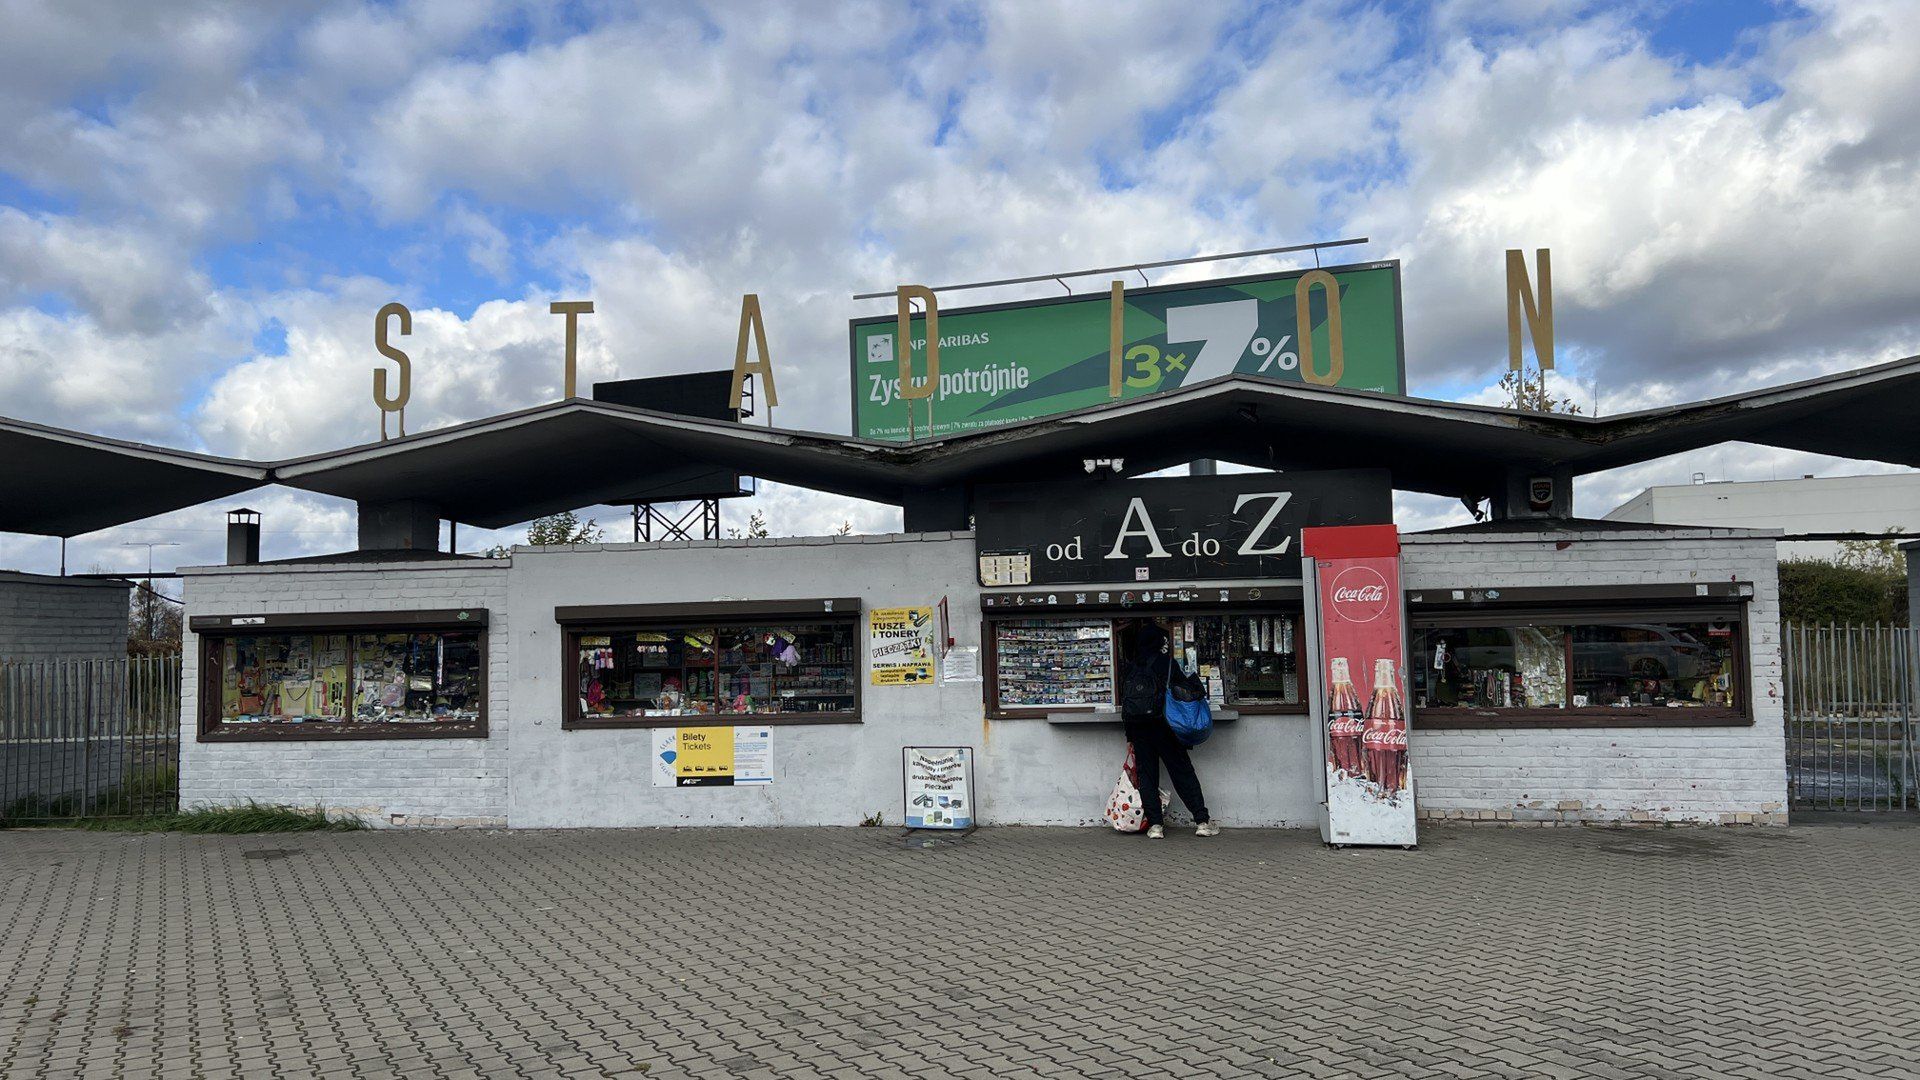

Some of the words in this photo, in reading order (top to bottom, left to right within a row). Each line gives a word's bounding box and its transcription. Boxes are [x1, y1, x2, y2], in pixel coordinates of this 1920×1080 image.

[373, 248, 1554, 412] STADION
[937, 332, 990, 348] ARIBAS
[939, 361, 1029, 401] potrójnie
[1046, 536, 1083, 560] od
[1104, 497, 1172, 559] A
[1181, 532, 1220, 557] do
[1233, 491, 1293, 556] Z
[1334, 585, 1385, 602] Coca-Cola
[872, 622, 905, 630] TUSZE
[879, 630, 919, 638] TONERY
[872, 637, 922, 658] PIECZĄTKI
[1328, 717, 1364, 732] Coca-Cola
[682, 733, 706, 741] Bilety
[1363, 728, 1408, 743] Coca-Cola
[683, 742, 711, 750] Tickets
